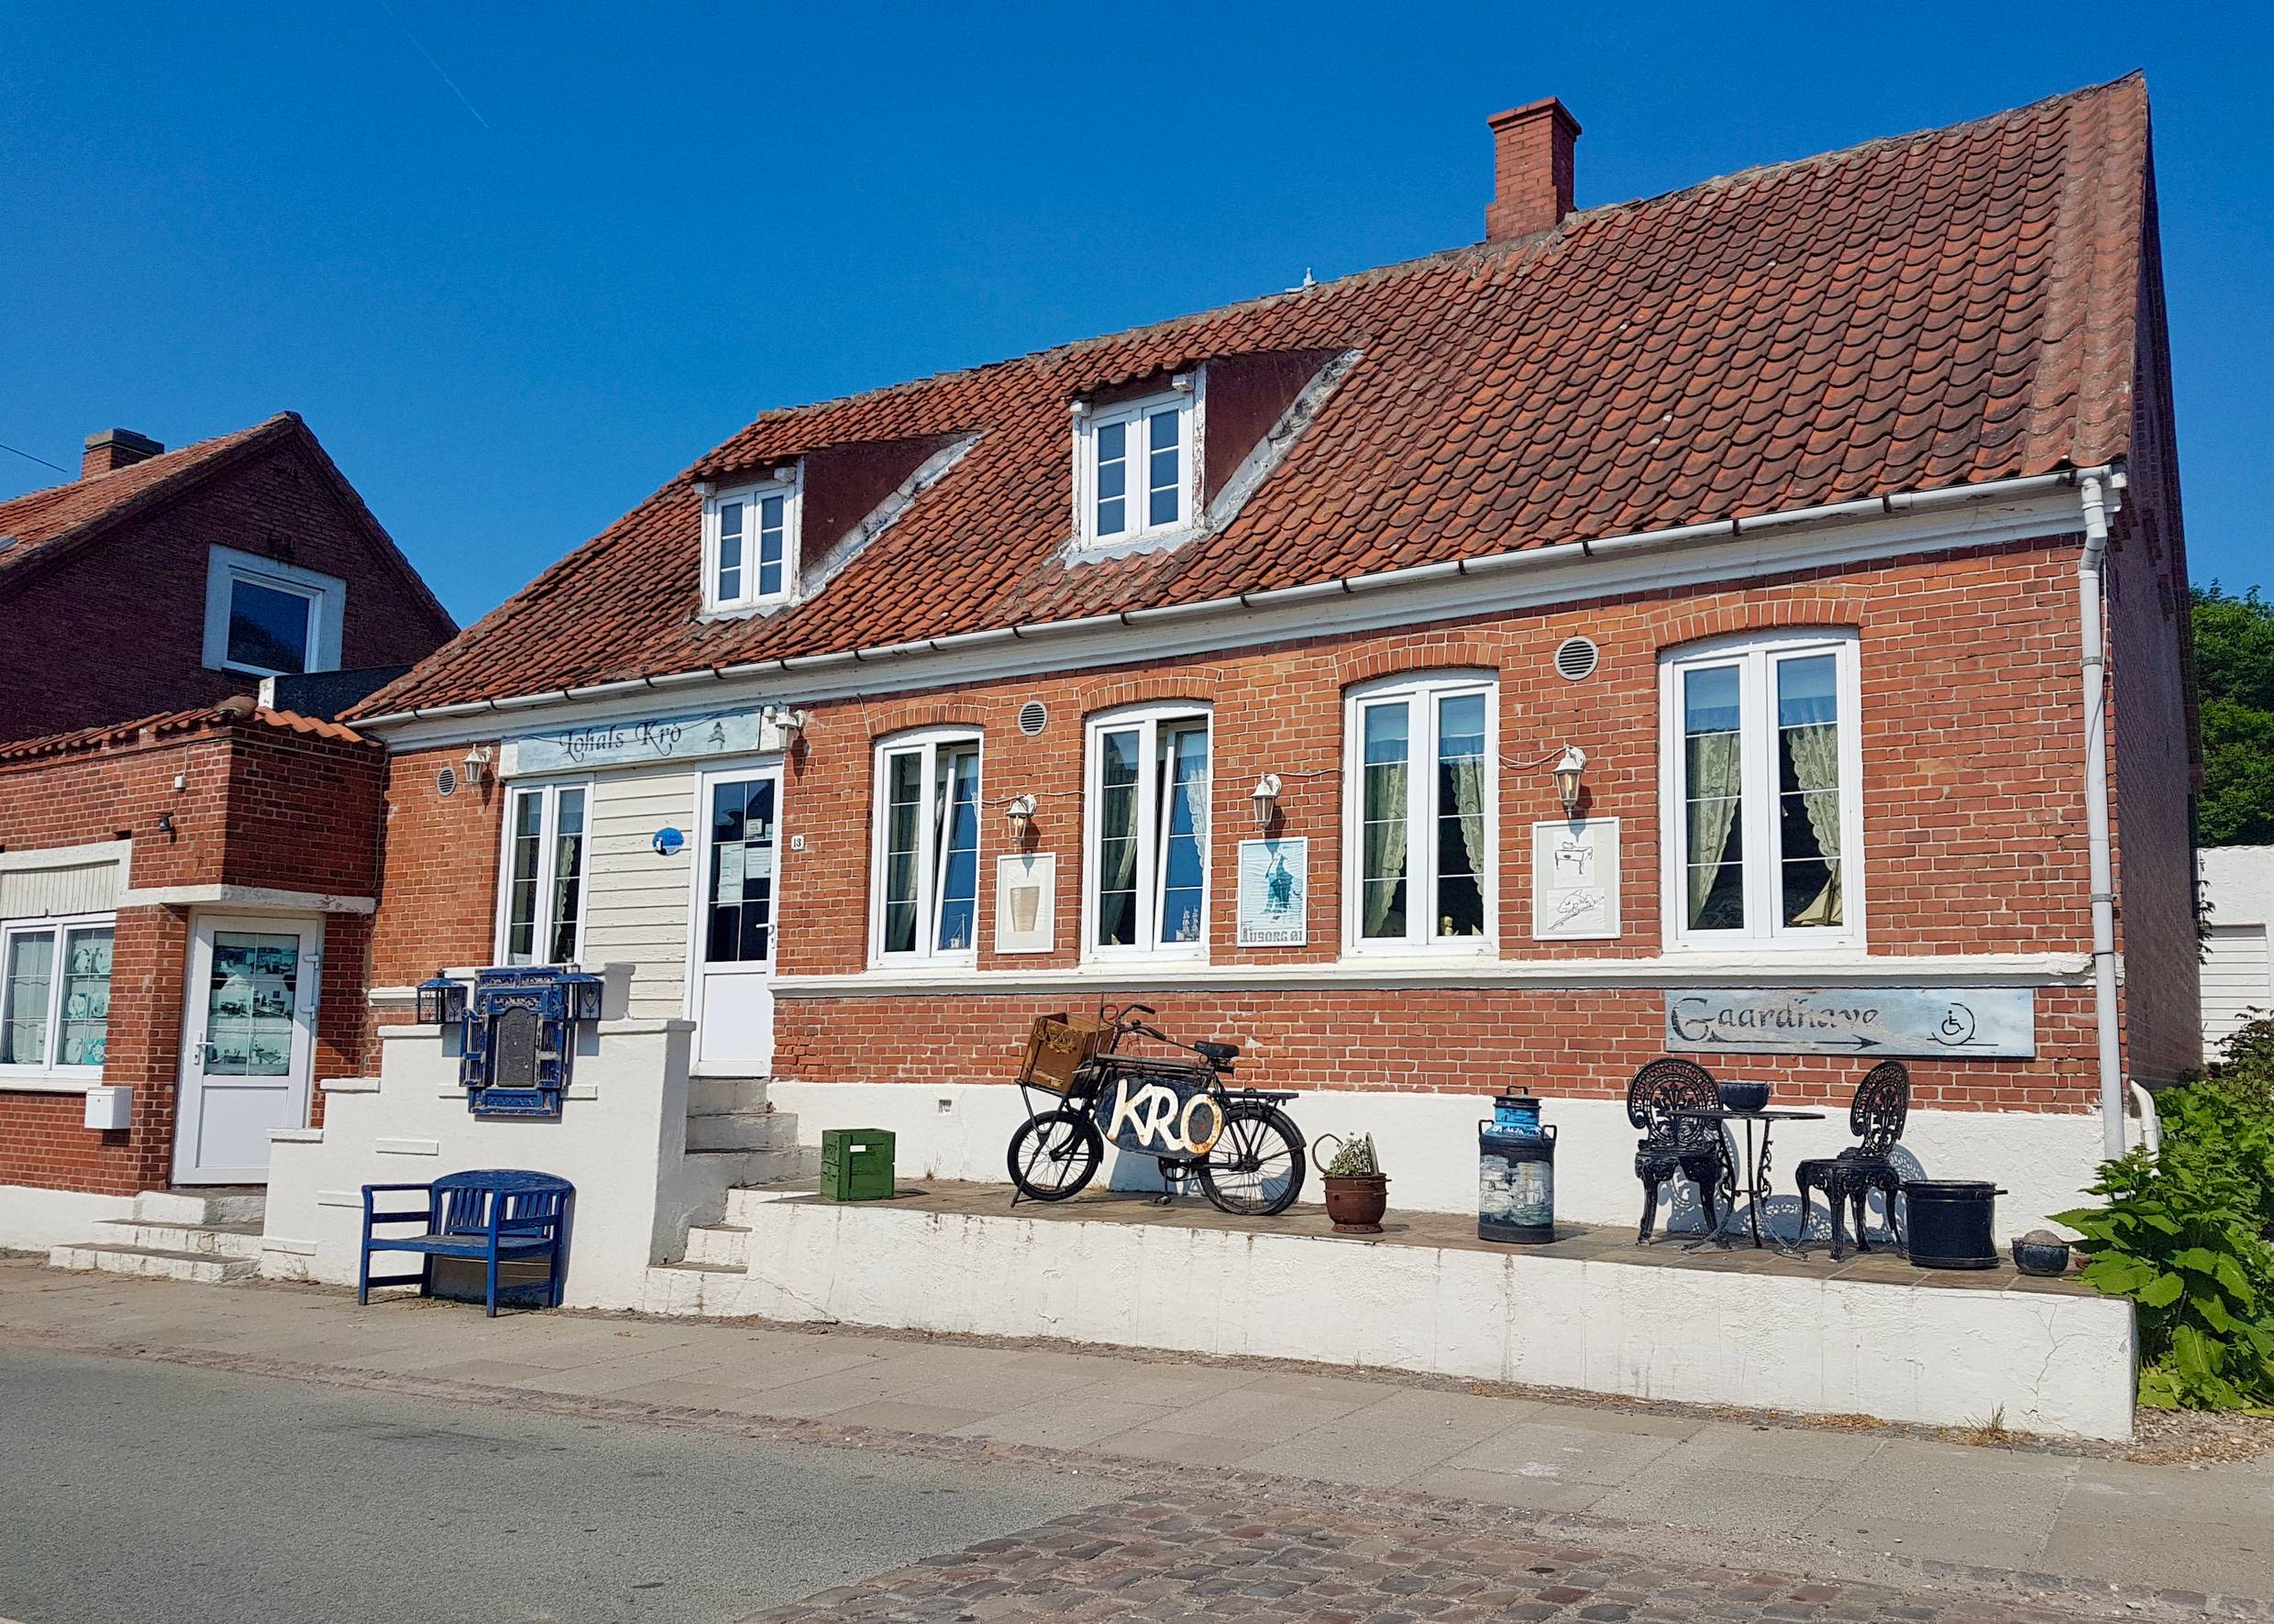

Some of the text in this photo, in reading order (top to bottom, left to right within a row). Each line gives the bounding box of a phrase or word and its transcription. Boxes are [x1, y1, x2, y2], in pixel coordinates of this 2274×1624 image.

[559, 724, 624, 763] Lohals
[793, 837, 801, 848] 13
[1106, 1077, 1223, 1154] KRO
